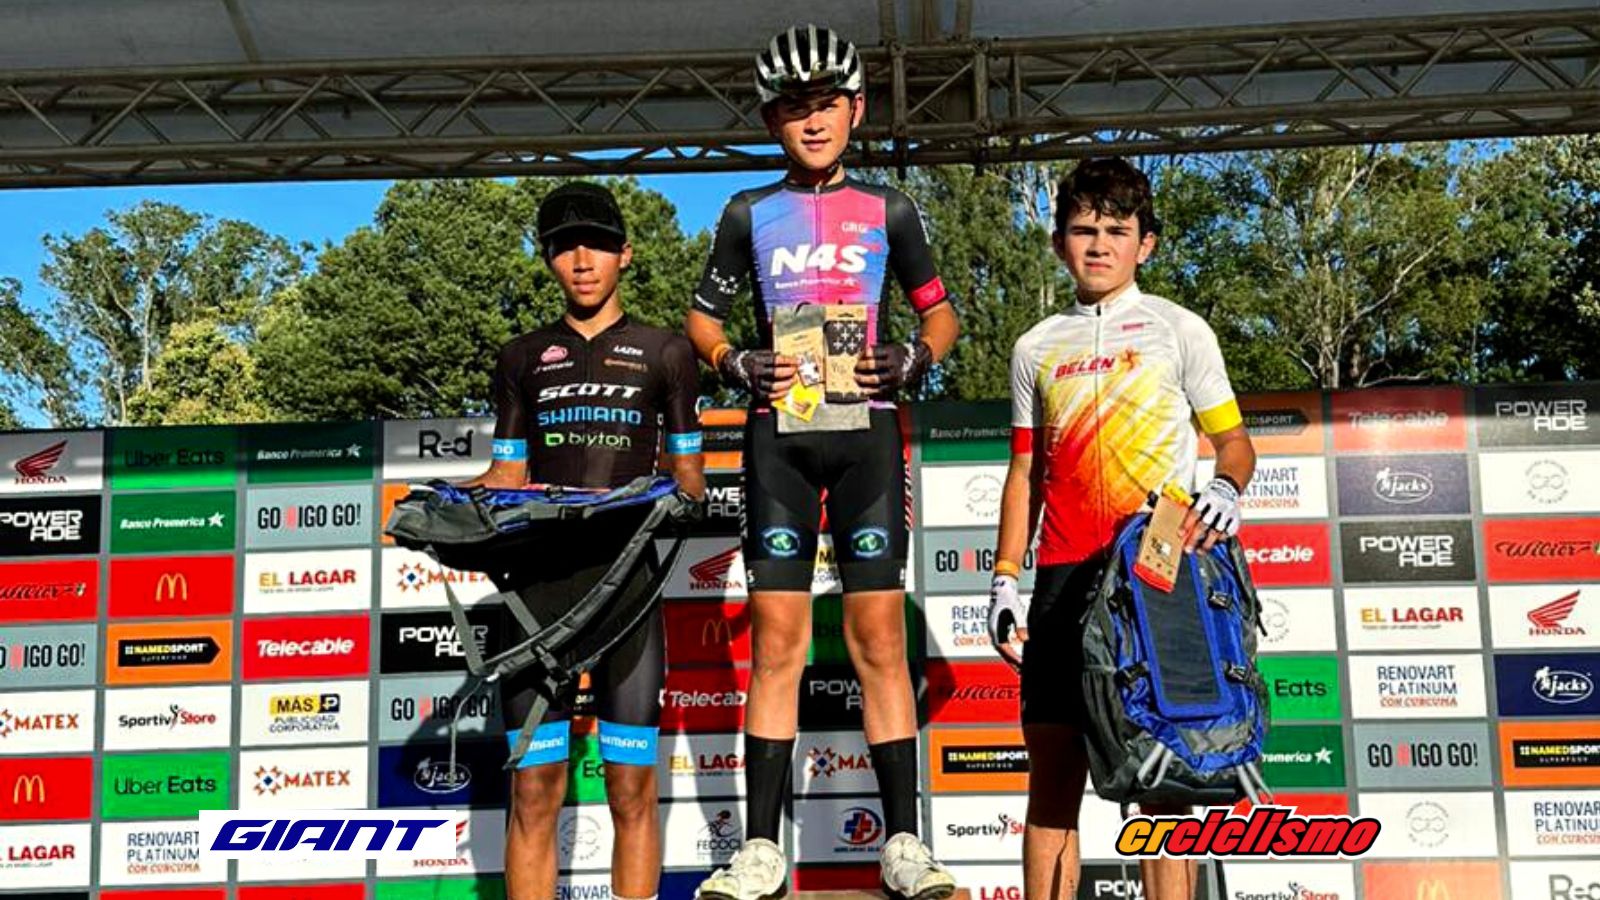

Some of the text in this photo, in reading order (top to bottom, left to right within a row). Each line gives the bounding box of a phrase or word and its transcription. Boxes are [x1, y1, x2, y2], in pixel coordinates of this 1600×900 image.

[770, 243, 869, 276] N4S
[537, 382, 642, 402] SCOTT
[538, 406, 642, 426] SHIMANO
[1495, 400, 1587, 417] POWER
[1349, 411, 1448, 427] Telecable
[1534, 416, 1588, 432] ADE
[930, 428, 961, 439] Banco
[124, 448, 225, 467] Uber Eats
[257, 449, 343, 461] Banco Promerica
[15, 475, 68, 485] HONDA
[258, 507, 281, 529] GO
[332, 503, 361, 527] GO!
[708, 503, 742, 517] AD
[120, 517, 205, 530] Banco Promerica
[30, 525, 82, 541] ADE
[1360, 535, 1454, 552] POWER
[936, 550, 959, 572] GO
[1244, 546, 1314, 563] ecable
[1400, 552, 1455, 567] ADE
[259, 570, 357, 587] EL LAGAR
[690, 582, 743, 590] HONDA
[1361, 607, 1464, 623] EL LAGAR
[400, 625, 488, 643] POWR
[1529, 626, 1586, 636] HONDA
[57, 643, 86, 667] GO!
[257, 637, 355, 657] Telecable
[1378, 665, 1456, 681] RENOVART
[1275, 678, 1328, 697] Eats
[1378, 683, 1458, 695] PLATINUM
[1550, 676, 1588, 697] jacks
[392, 698, 415, 721] GO
[14, 713, 79, 731] MATEX
[669, 754, 746, 771] EL LAG
[1368, 743, 1392, 768] GO
[1448, 742, 1479, 767] GO!
[114, 776, 217, 795] Uber Eats
[284, 770, 350, 788] MATEX
[1534, 801, 1600, 817] RENOVAR
[1535, 818, 1600, 833] PLATINU
[9, 844, 76, 861] LAGAR
[413, 858, 469, 867] HONDA
